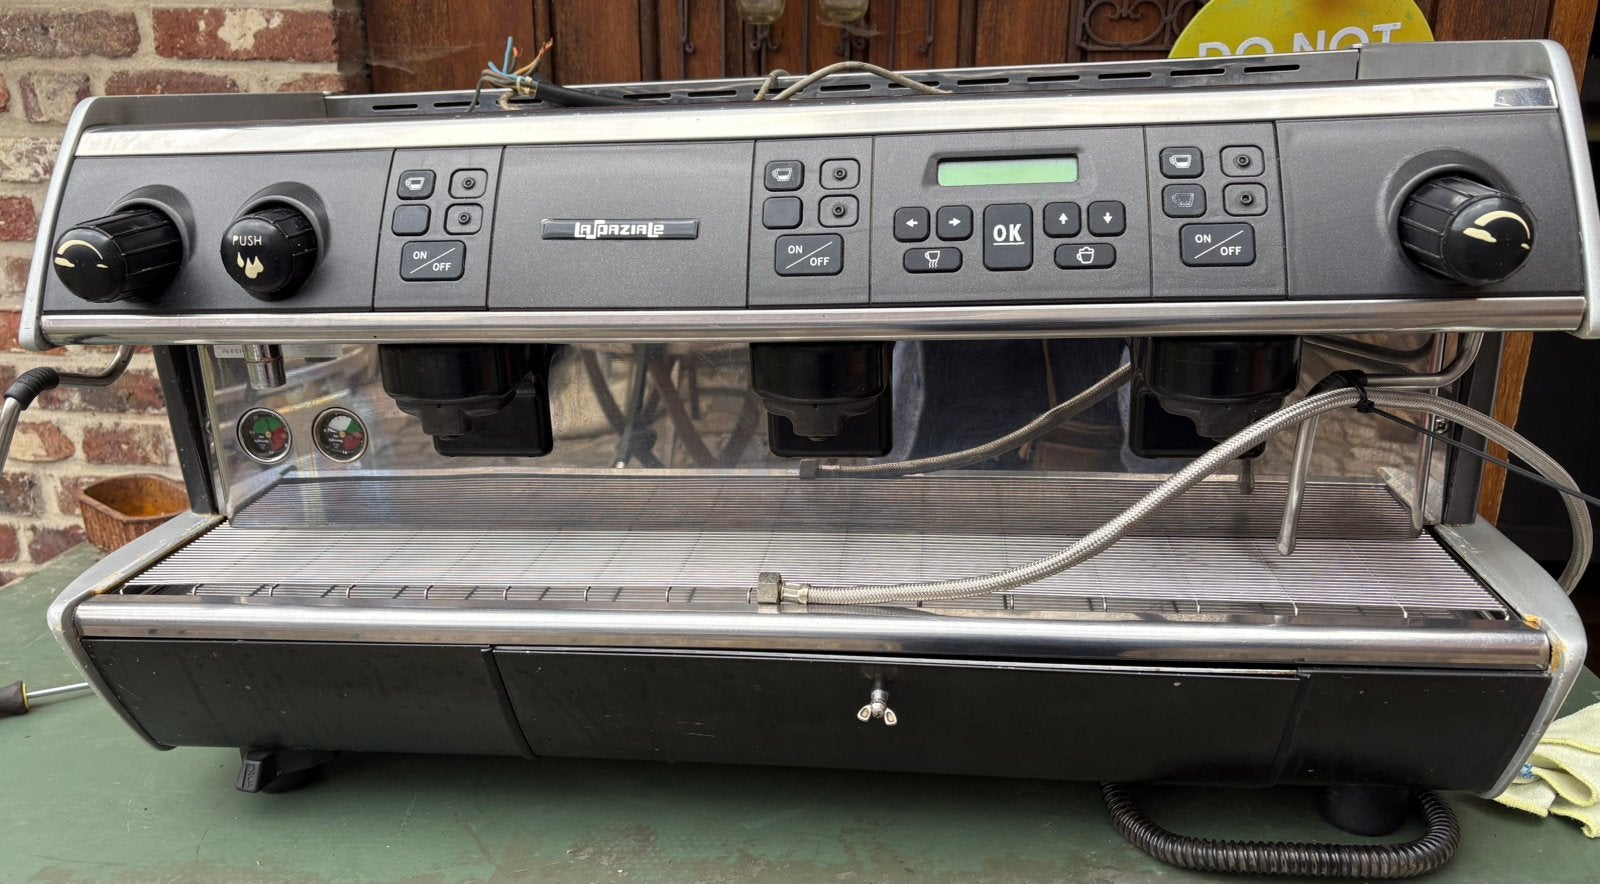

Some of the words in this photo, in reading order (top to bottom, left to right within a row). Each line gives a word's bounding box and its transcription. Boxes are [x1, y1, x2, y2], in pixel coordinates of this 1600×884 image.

[1293, 22, 1402, 52] NOT
[993, 223, 1022, 242] OK
[232, 235, 262, 246] PUSH
[1194, 233, 1212, 243] ON
[787, 244, 803, 254] ON
[1220, 246, 1242, 256] OFF
[412, 250, 428, 260] ON
[809, 256, 830, 266] OFF
[432, 262, 452, 271] OFF
